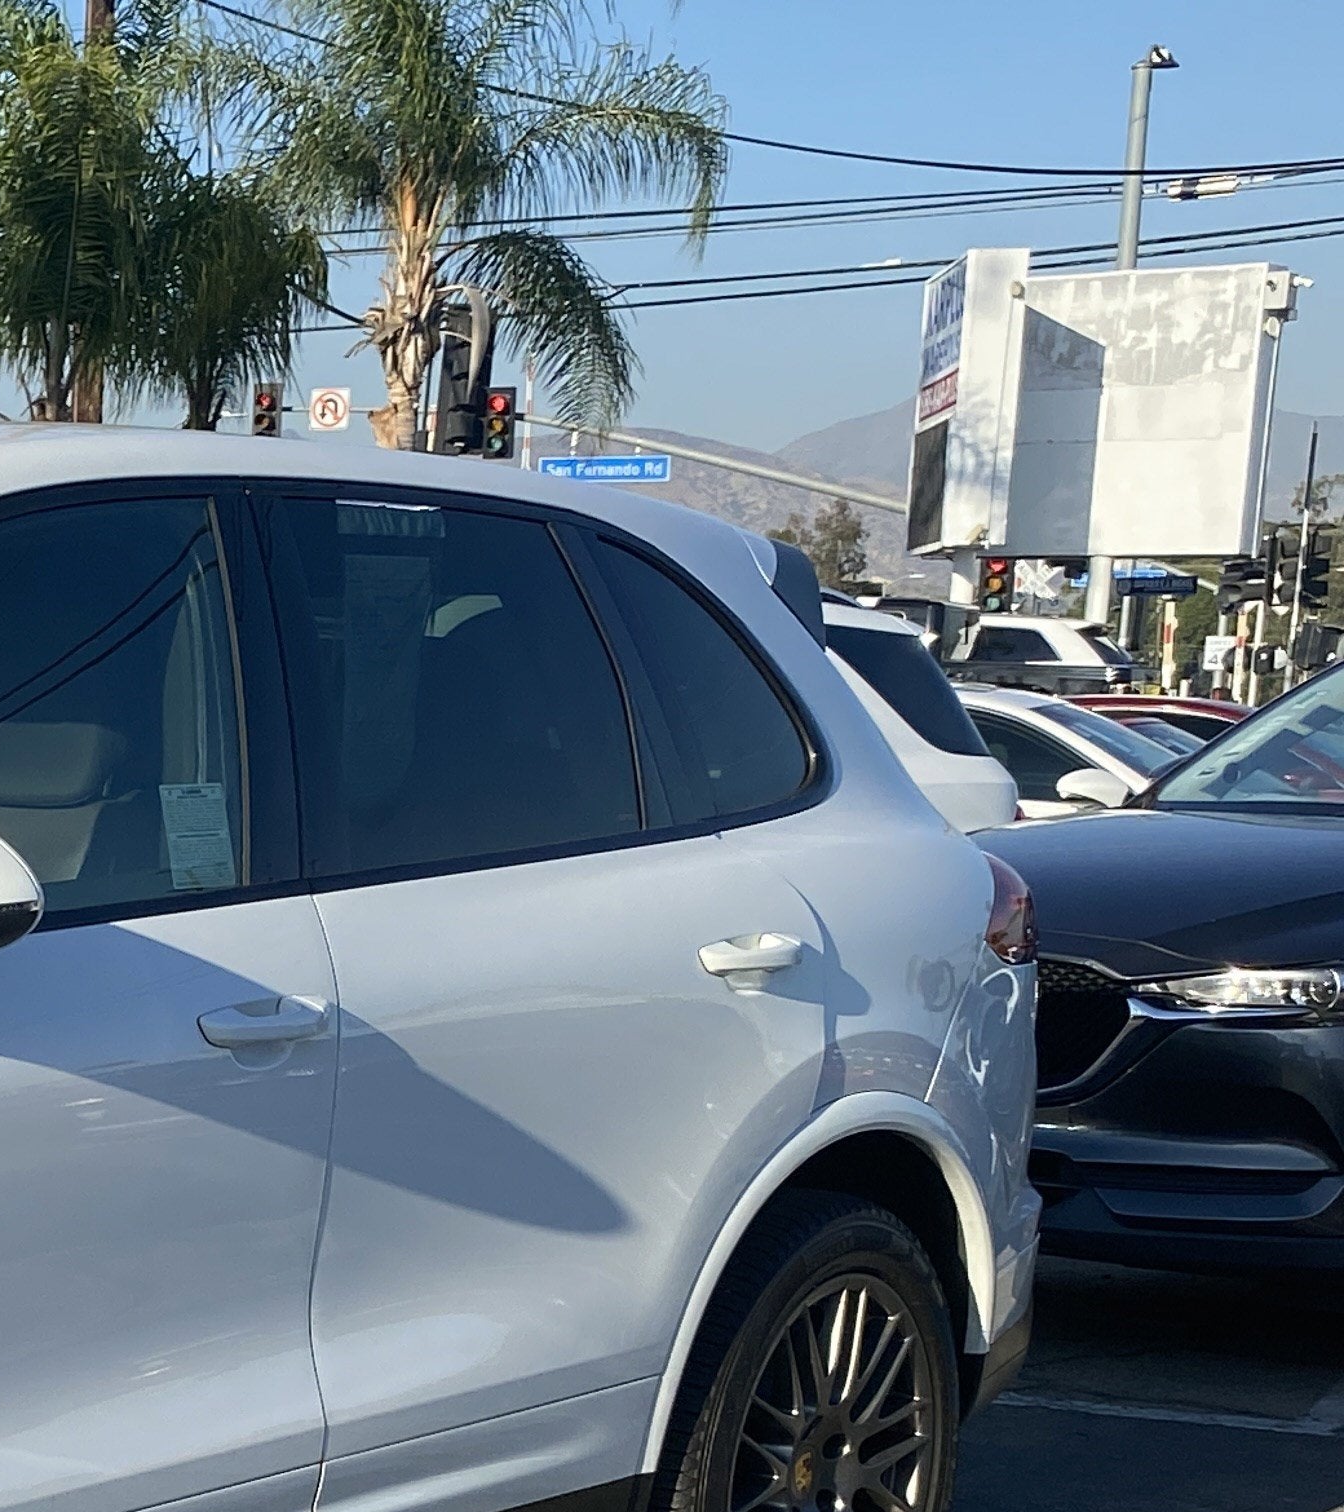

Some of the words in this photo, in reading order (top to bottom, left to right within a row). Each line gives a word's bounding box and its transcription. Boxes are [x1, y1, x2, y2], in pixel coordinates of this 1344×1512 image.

[546, 463, 572, 477] San
[576, 463, 641, 477] Fernando
[644, 462, 663, 476] Rd
